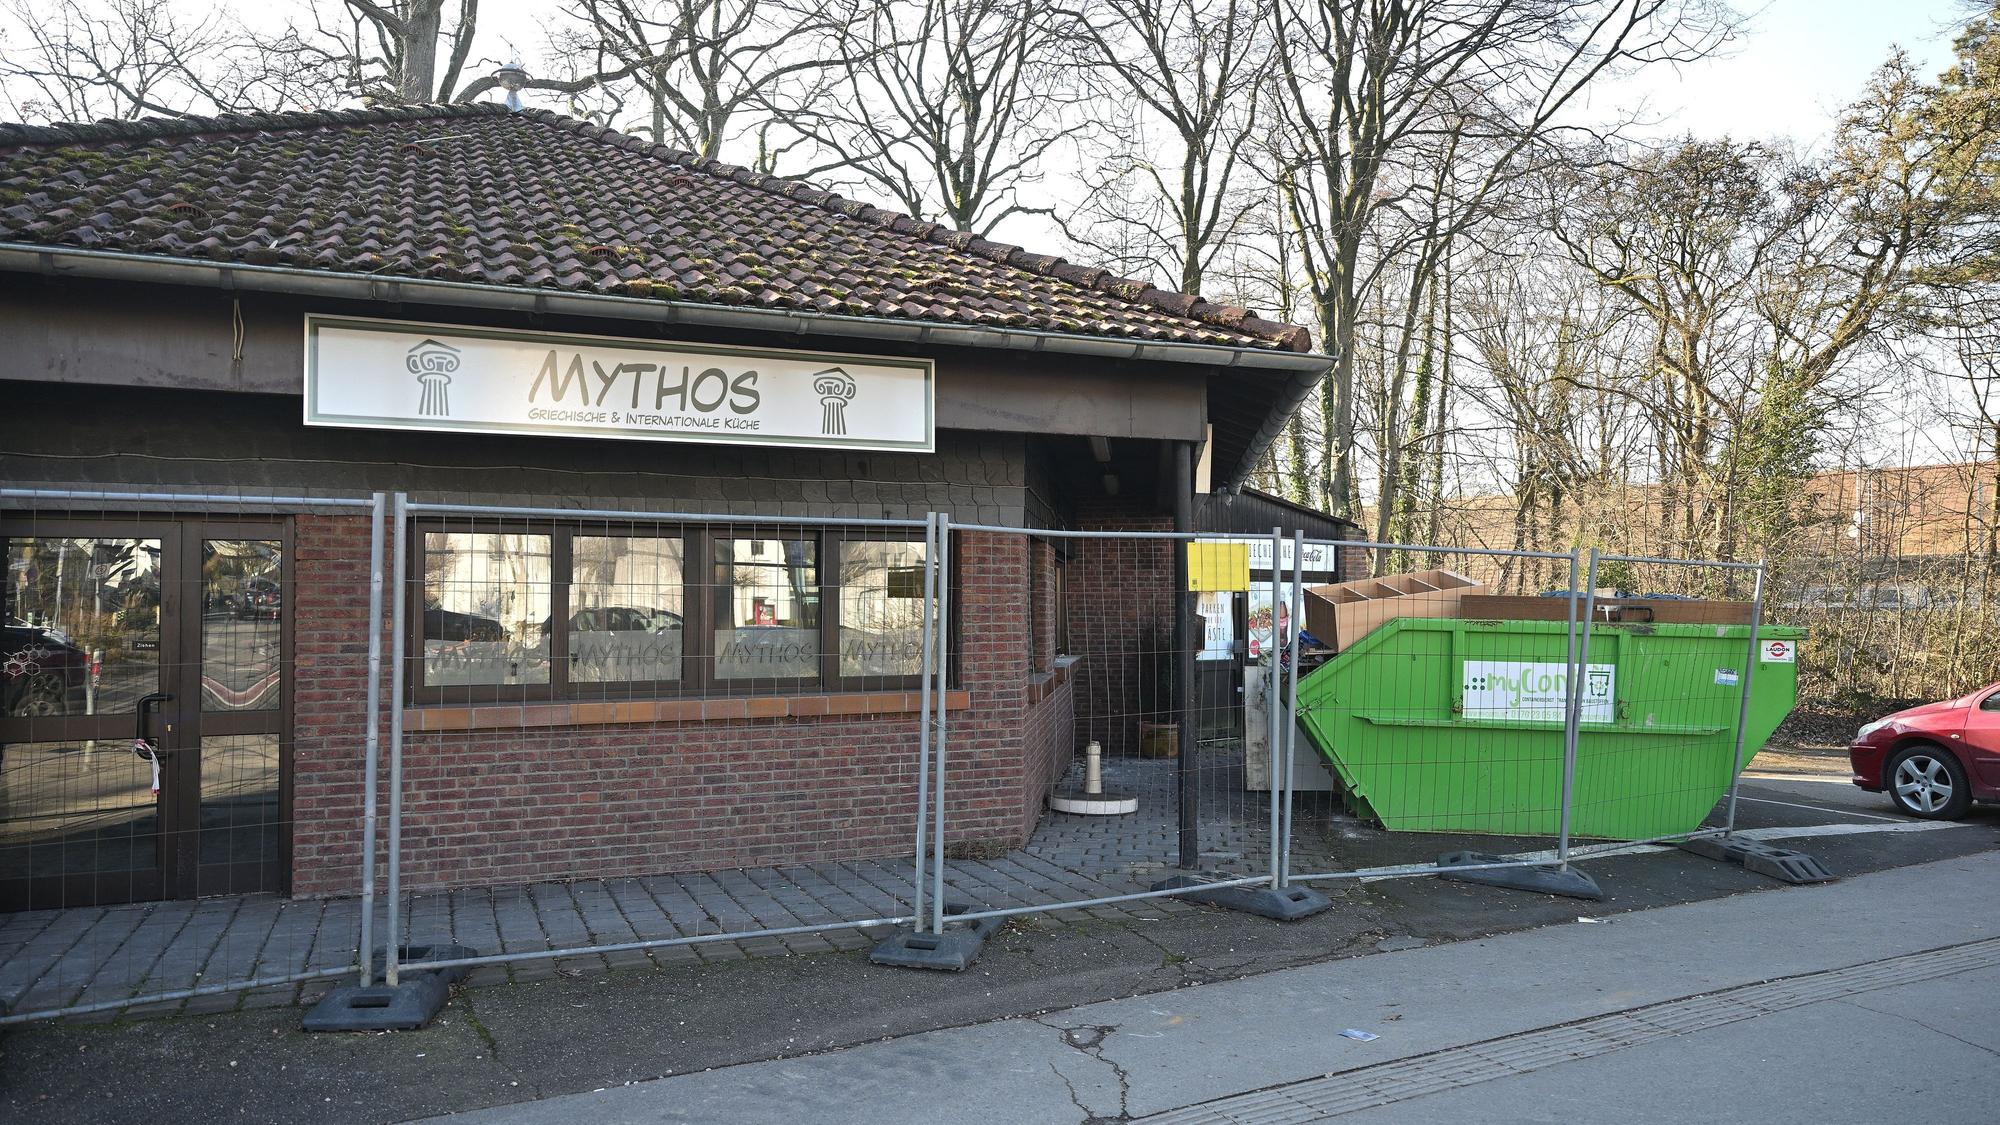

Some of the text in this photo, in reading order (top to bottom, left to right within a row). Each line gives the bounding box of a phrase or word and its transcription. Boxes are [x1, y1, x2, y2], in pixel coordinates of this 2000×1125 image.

[528, 350, 760, 415] MYTHOS
[528, 408, 760, 431] GRIECHISCHE & INTERNATIONALE KÜCHE
[575, 641, 674, 666] MYTHOS
[719, 641, 814, 664] MYTHOS
